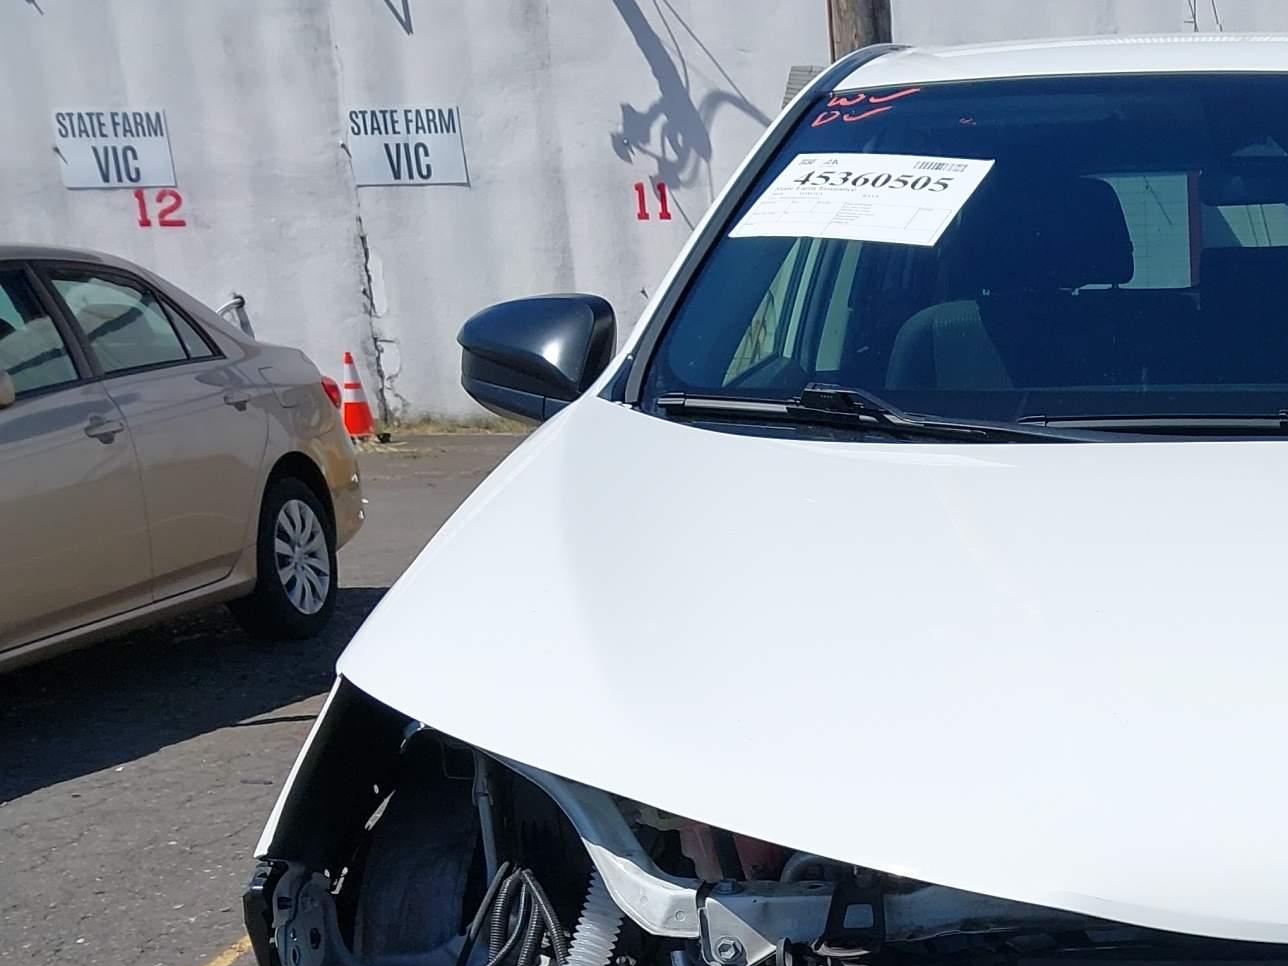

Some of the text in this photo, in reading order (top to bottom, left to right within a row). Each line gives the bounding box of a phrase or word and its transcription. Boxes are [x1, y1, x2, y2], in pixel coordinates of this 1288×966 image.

[56, 112, 164, 138] STATE FARM
[349, 108, 456, 136] STATE FARM
[91, 145, 141, 183] VIC
[384, 142, 432, 180] VIC
[793, 171, 954, 192] 45360505
[133, 188, 186, 227] 12
[634, 182, 671, 220] 11
